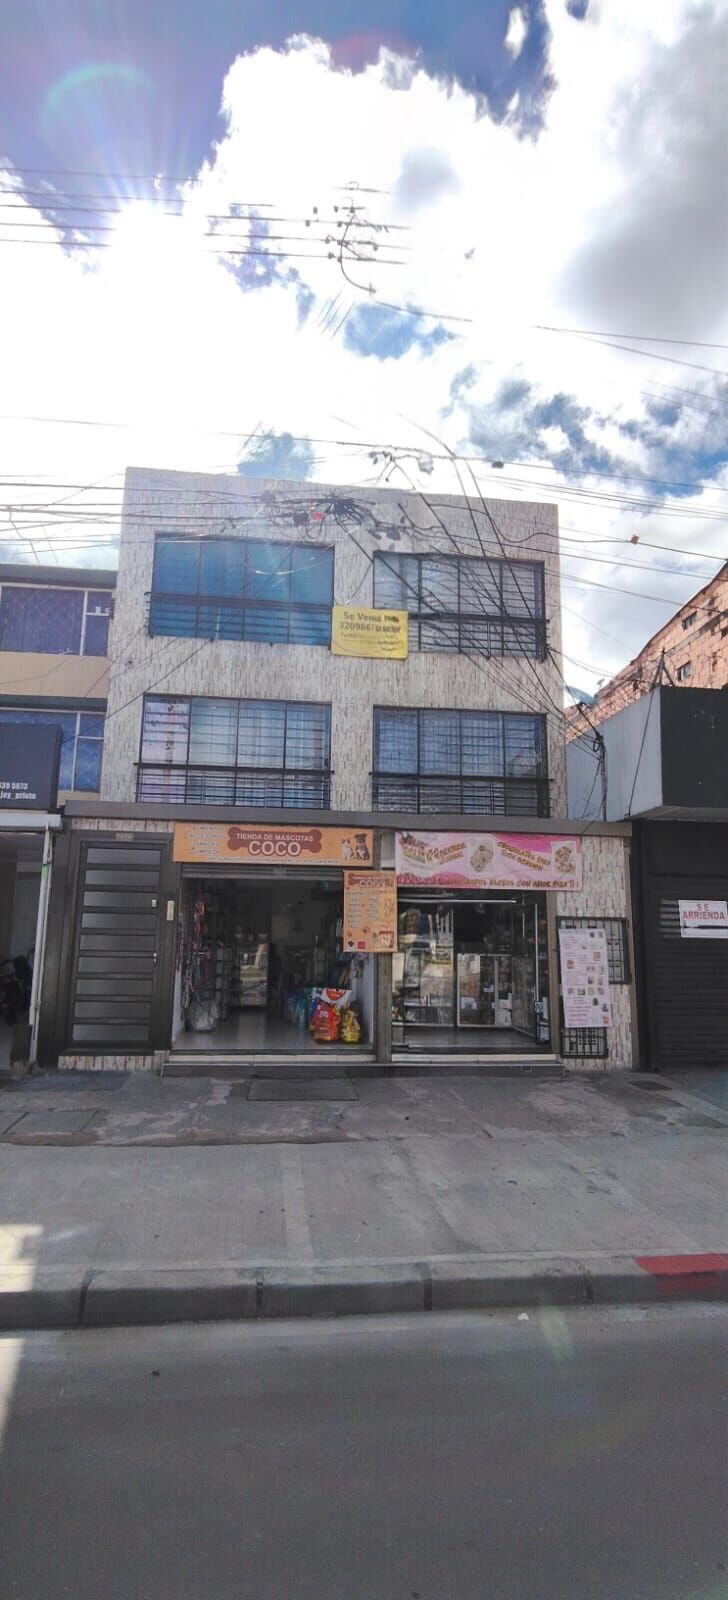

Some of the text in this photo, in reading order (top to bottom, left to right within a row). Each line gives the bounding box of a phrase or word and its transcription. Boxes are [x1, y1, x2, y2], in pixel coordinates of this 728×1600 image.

[343, 611, 355, 620] Se
[236, 832, 314, 842] TIENDA DE MASCOTAS
[248, 839, 302, 857] COCO
[697, 903, 710, 911] SE
[683, 911, 725, 920] ARRIENDA
